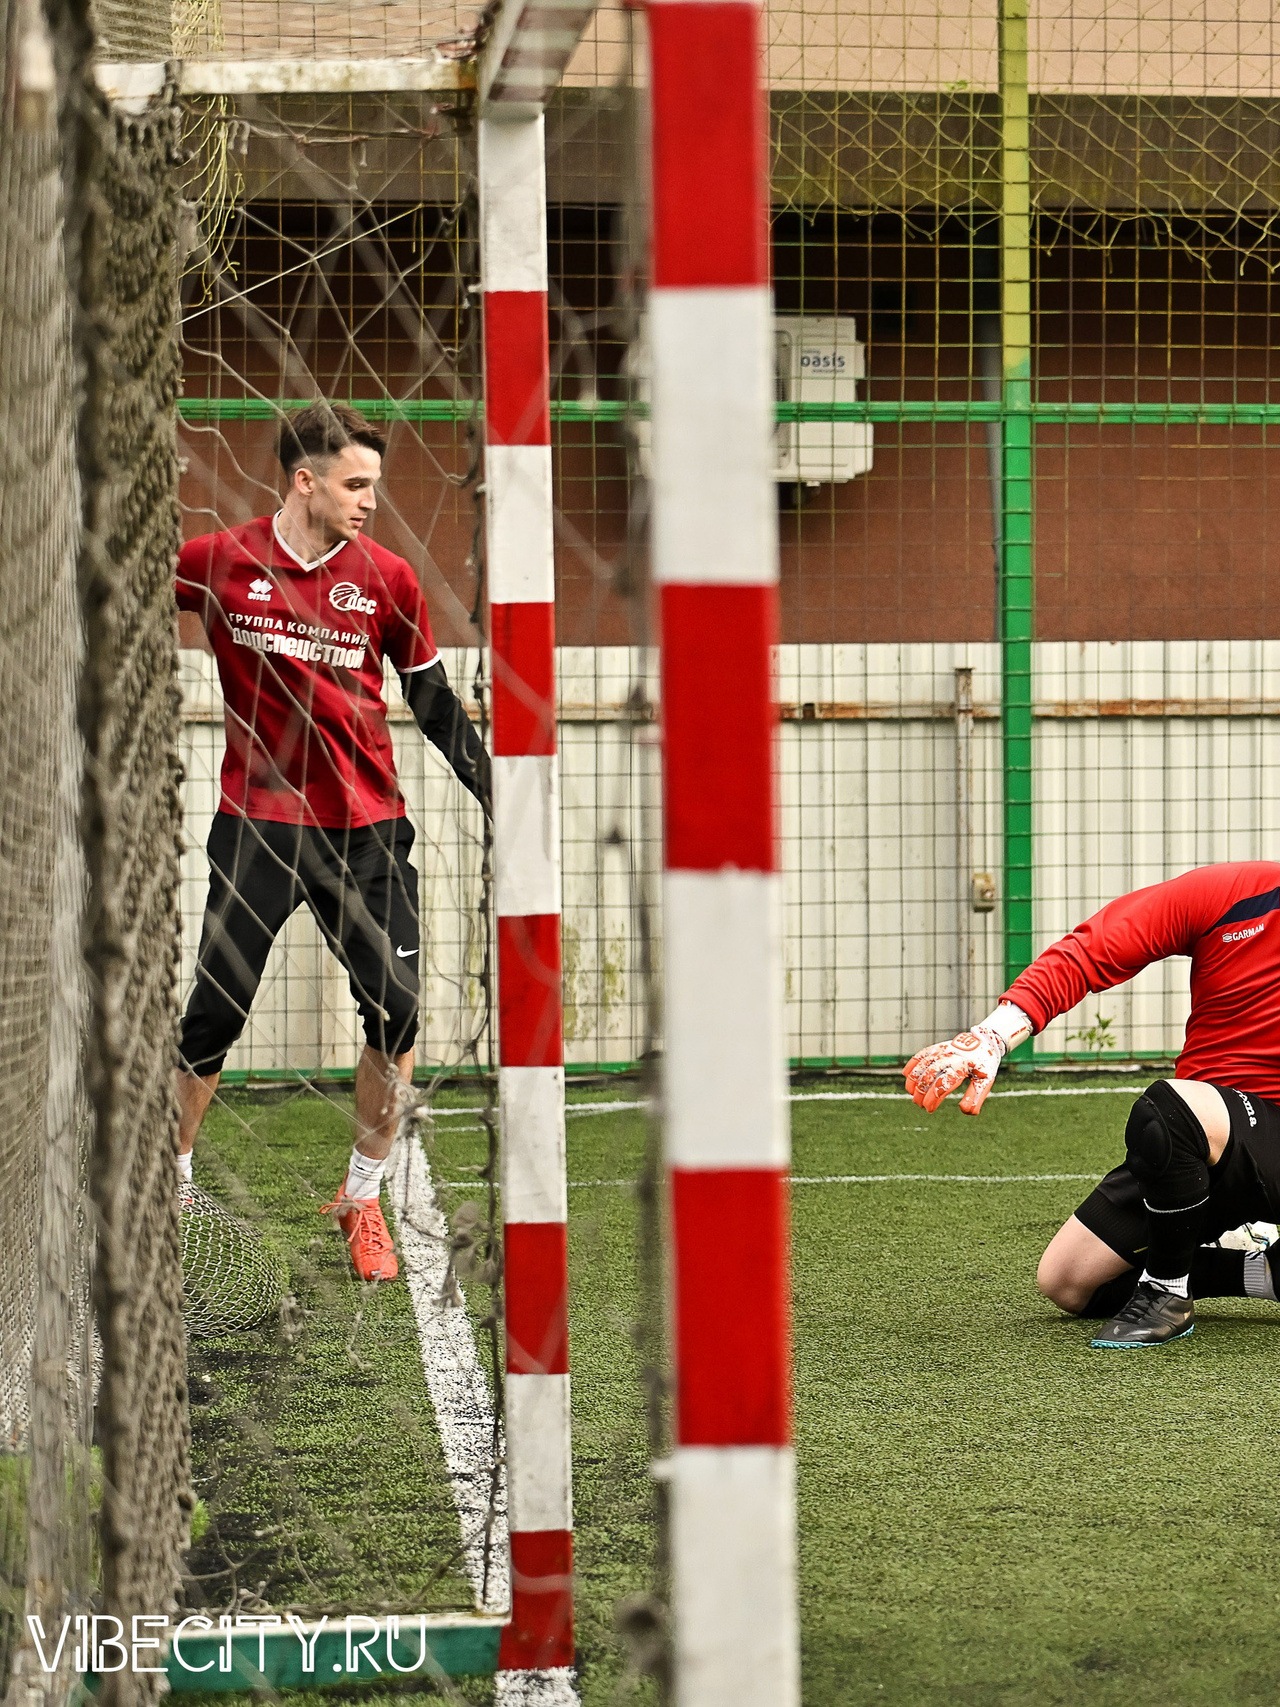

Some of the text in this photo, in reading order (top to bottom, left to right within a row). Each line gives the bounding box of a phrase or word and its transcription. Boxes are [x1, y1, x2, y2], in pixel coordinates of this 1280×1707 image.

[801, 352, 845, 367] oasis
[229, 613, 370, 645] ГРУППА КОМПАНИЙ
[1232, 923, 1264, 941] GARMAN
